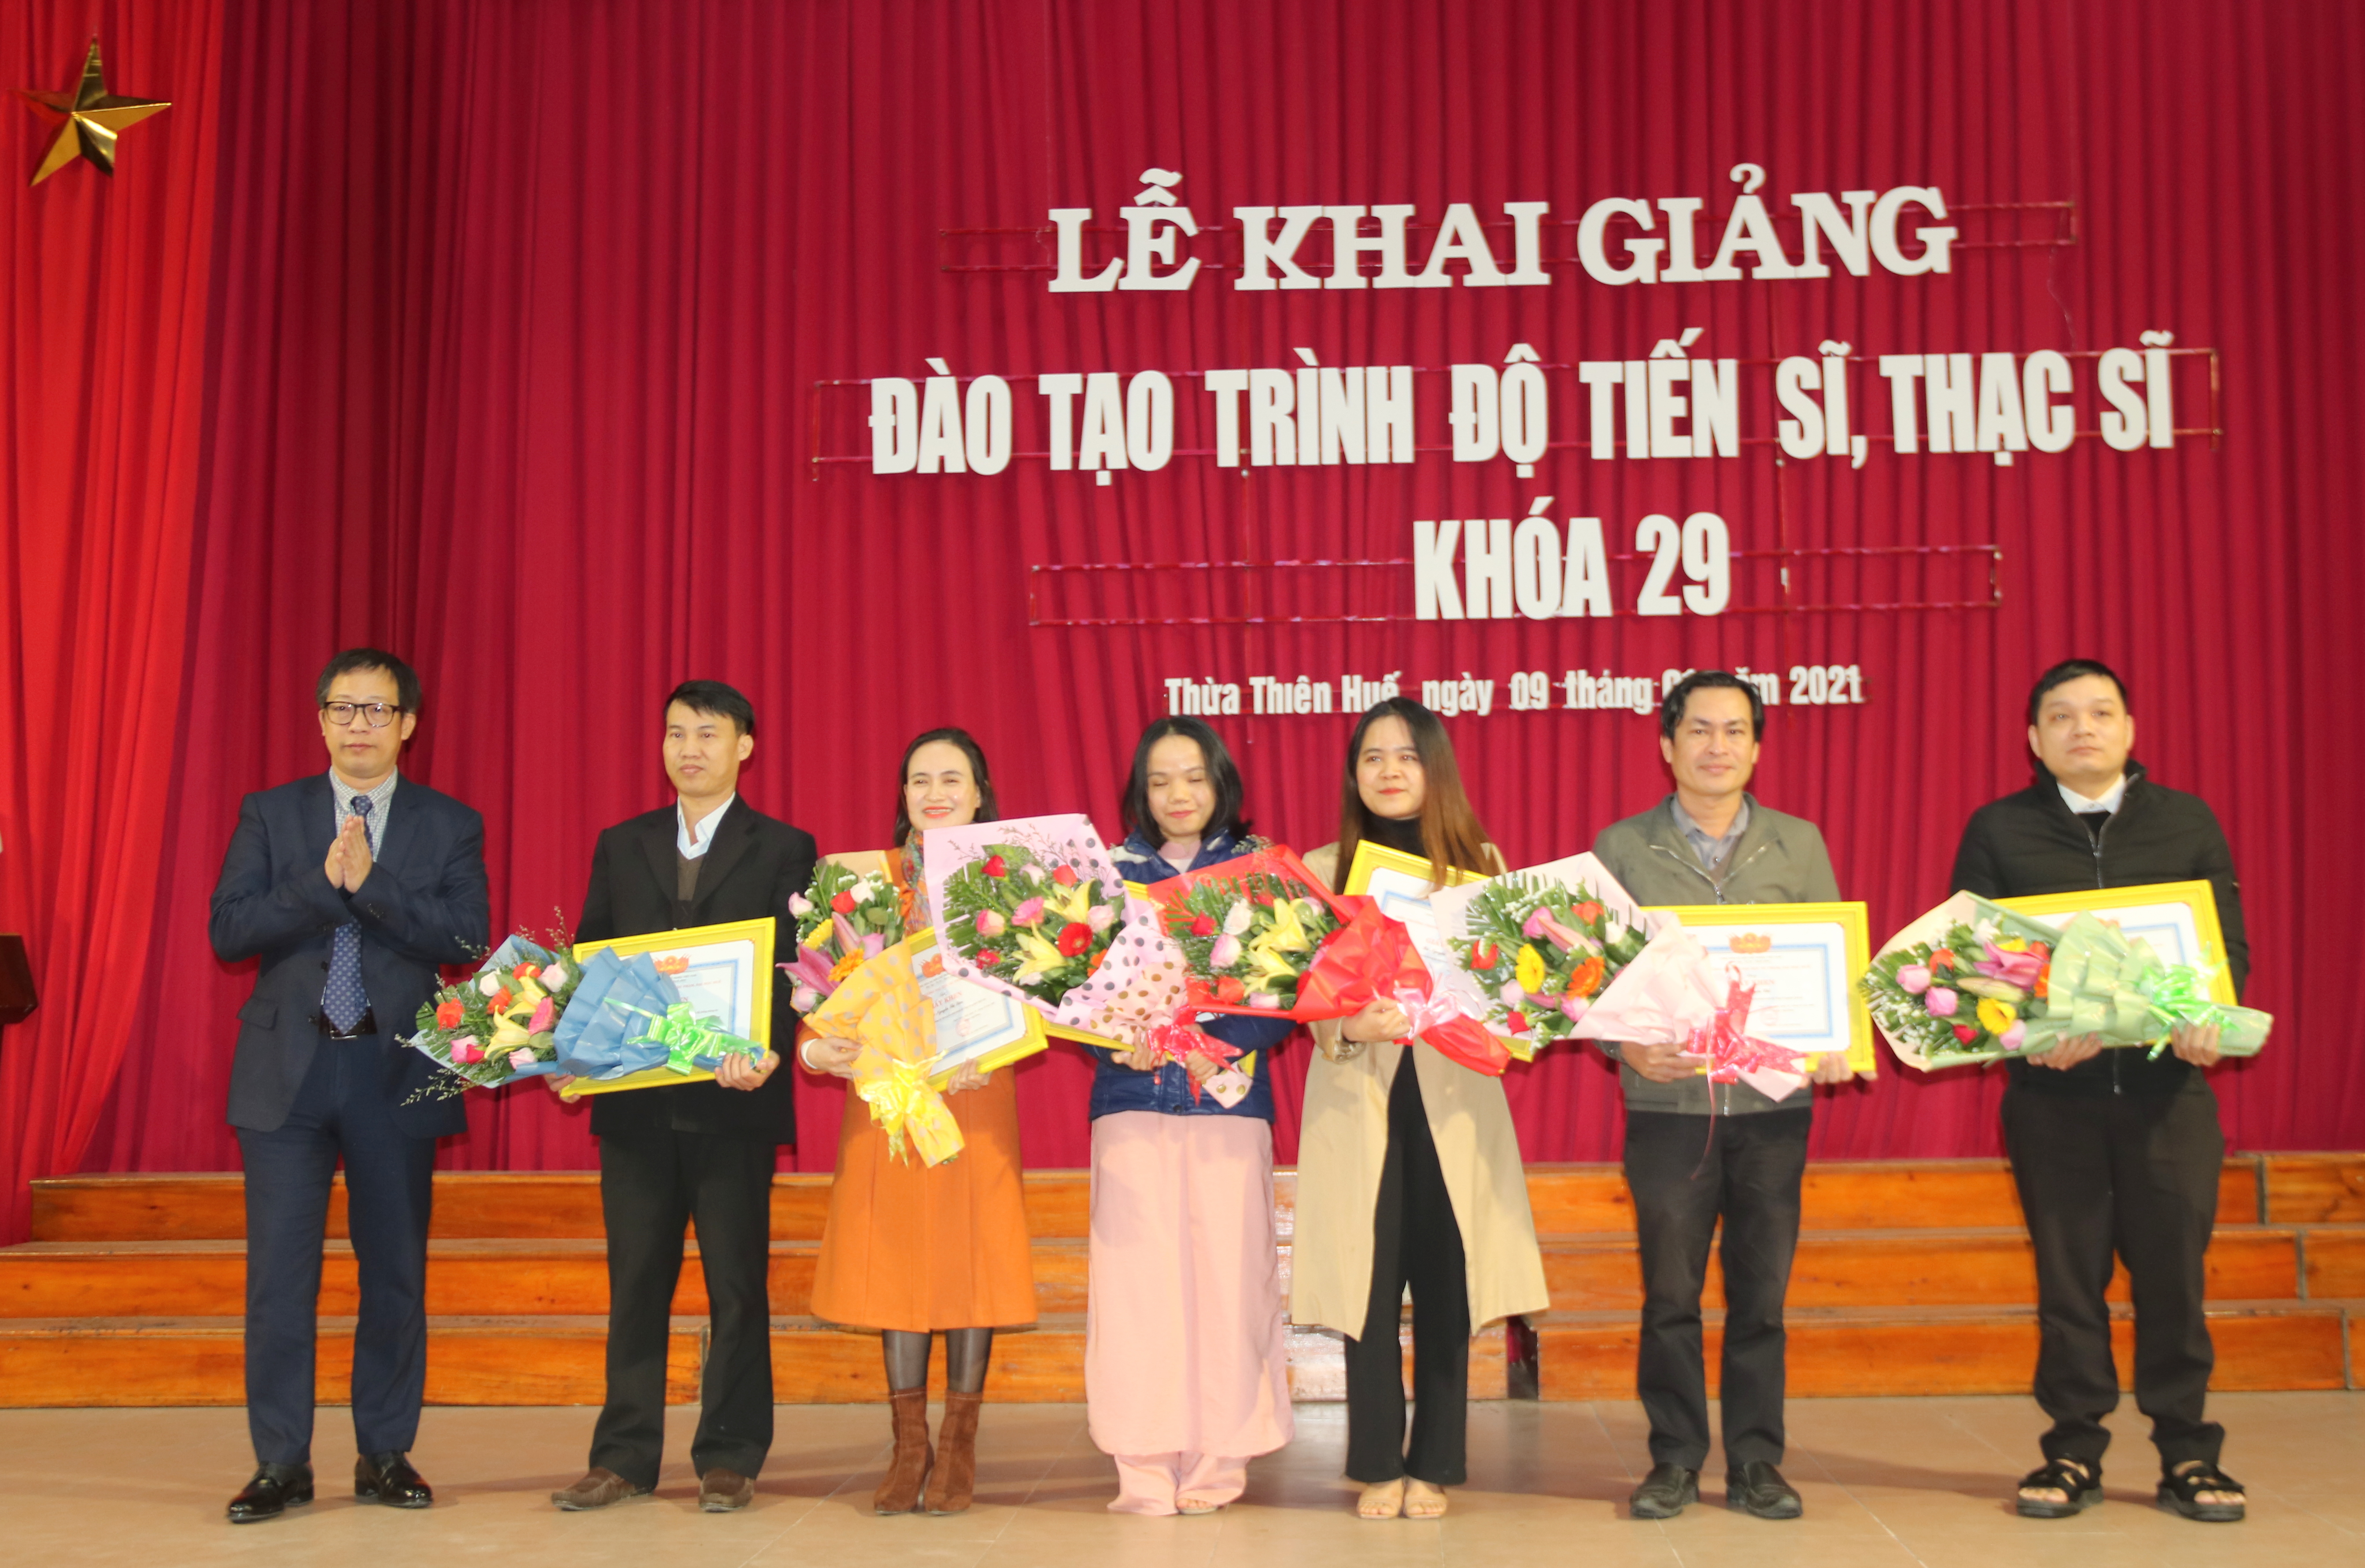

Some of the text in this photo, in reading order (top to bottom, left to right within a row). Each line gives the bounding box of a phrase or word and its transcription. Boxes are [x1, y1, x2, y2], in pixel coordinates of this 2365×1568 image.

[1048, 162, 1958, 292] LỄ KHAI GIẢNG
[868, 327, 2178, 486] ĐÀO TẠO TRÌNH ĐỘ TIẾN SĨ, THẠC SĨ
[1413, 496, 1730, 620] KHÓA 29
[1164, 676, 1240, 716] Thừa
[1421, 671, 1494, 717] ngày
[1510, 670, 1549, 710] 09
[1565, 669, 1653, 715] tháng
[1789, 665, 1864, 705] 2021
